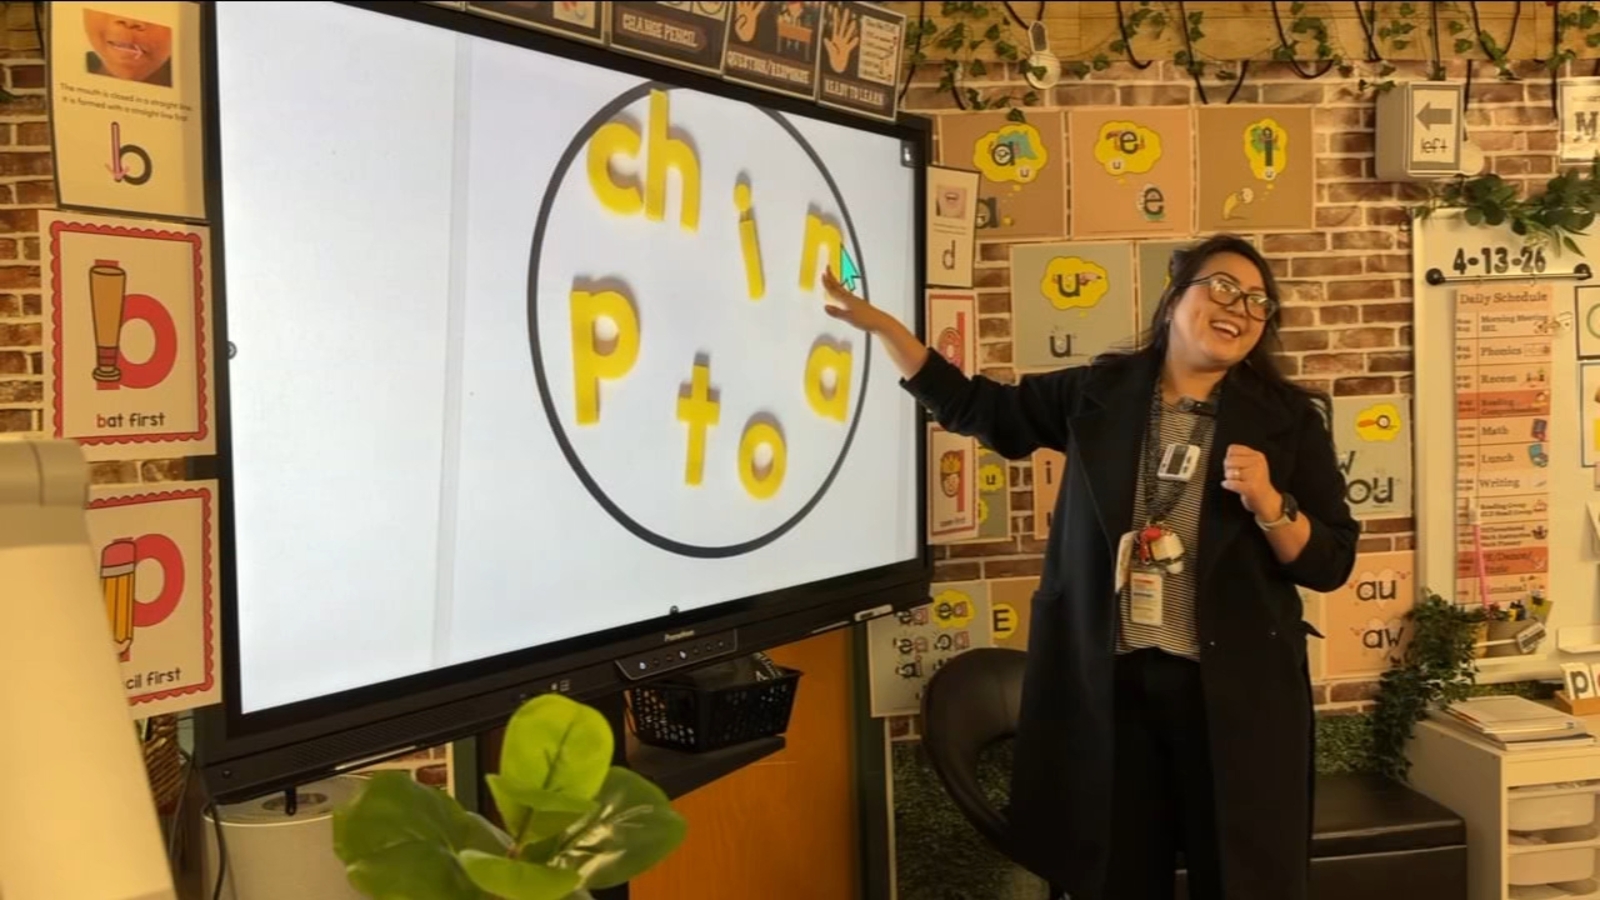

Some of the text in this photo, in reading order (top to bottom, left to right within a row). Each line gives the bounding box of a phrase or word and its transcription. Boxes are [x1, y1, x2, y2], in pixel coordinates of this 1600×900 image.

[109, 121, 152, 185] b
[1120, 131, 1138, 155] e
[1420, 137, 1449, 155] left
[1144, 187, 1165, 215] e
[733, 181, 766, 301] i
[798, 212, 843, 293] n
[942, 239, 956, 270] d
[1452, 246, 1547, 275] 4-13-26
[1058, 272, 1081, 298] u
[1460, 291, 1548, 306] Daily Schedule
[1481, 314, 1515, 324] Morning
[569, 289, 641, 426] p
[1049, 334, 1072, 358] u
[1481, 346, 1522, 356] Phonics
[803, 343, 854, 424] a
[97, 412, 165, 429] bat first
[675, 364, 721, 486] t
[1481, 426, 1509, 436] Math
[737, 421, 788, 501] o
[1481, 453, 1514, 463] Lunch
[1345, 477, 1394, 505] ou
[1479, 479, 1520, 489] Writing
[1356, 579, 1397, 602] au
[993, 609, 1011, 632] E
[1362, 627, 1404, 650] aw
[125, 667, 182, 690] cil first
